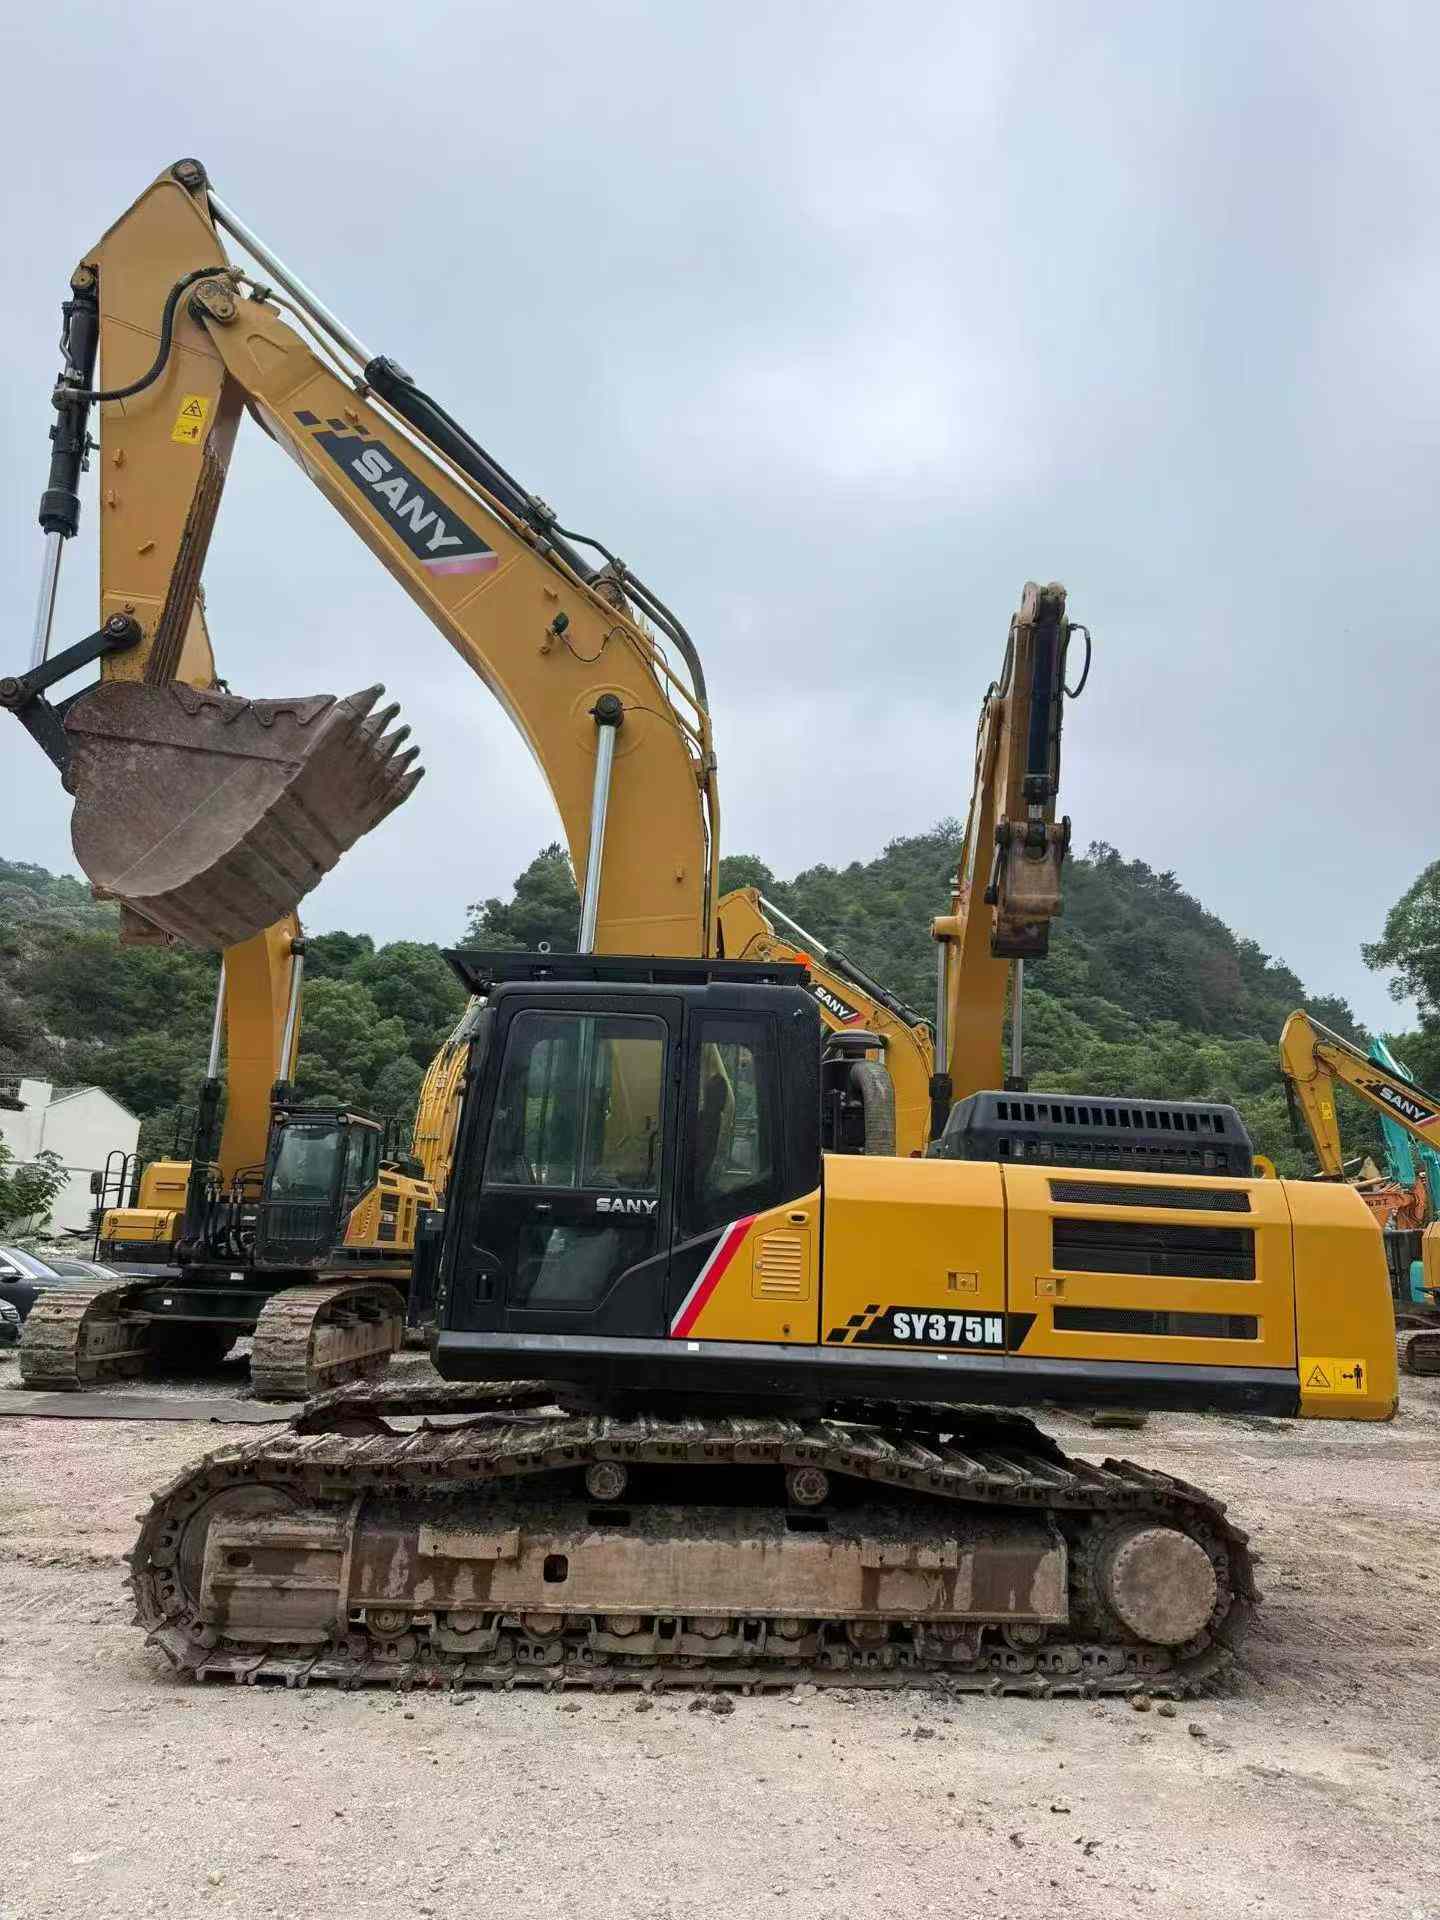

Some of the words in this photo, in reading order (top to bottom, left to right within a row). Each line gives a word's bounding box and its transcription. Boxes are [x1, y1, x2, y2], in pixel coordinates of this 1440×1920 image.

[352, 448, 463, 552] SANY
[814, 986, 849, 1016] SANY
[1380, 1087, 1426, 1119] SANY
[596, 1197, 658, 1214] SANY
[893, 1312, 1003, 1344] SY375H
